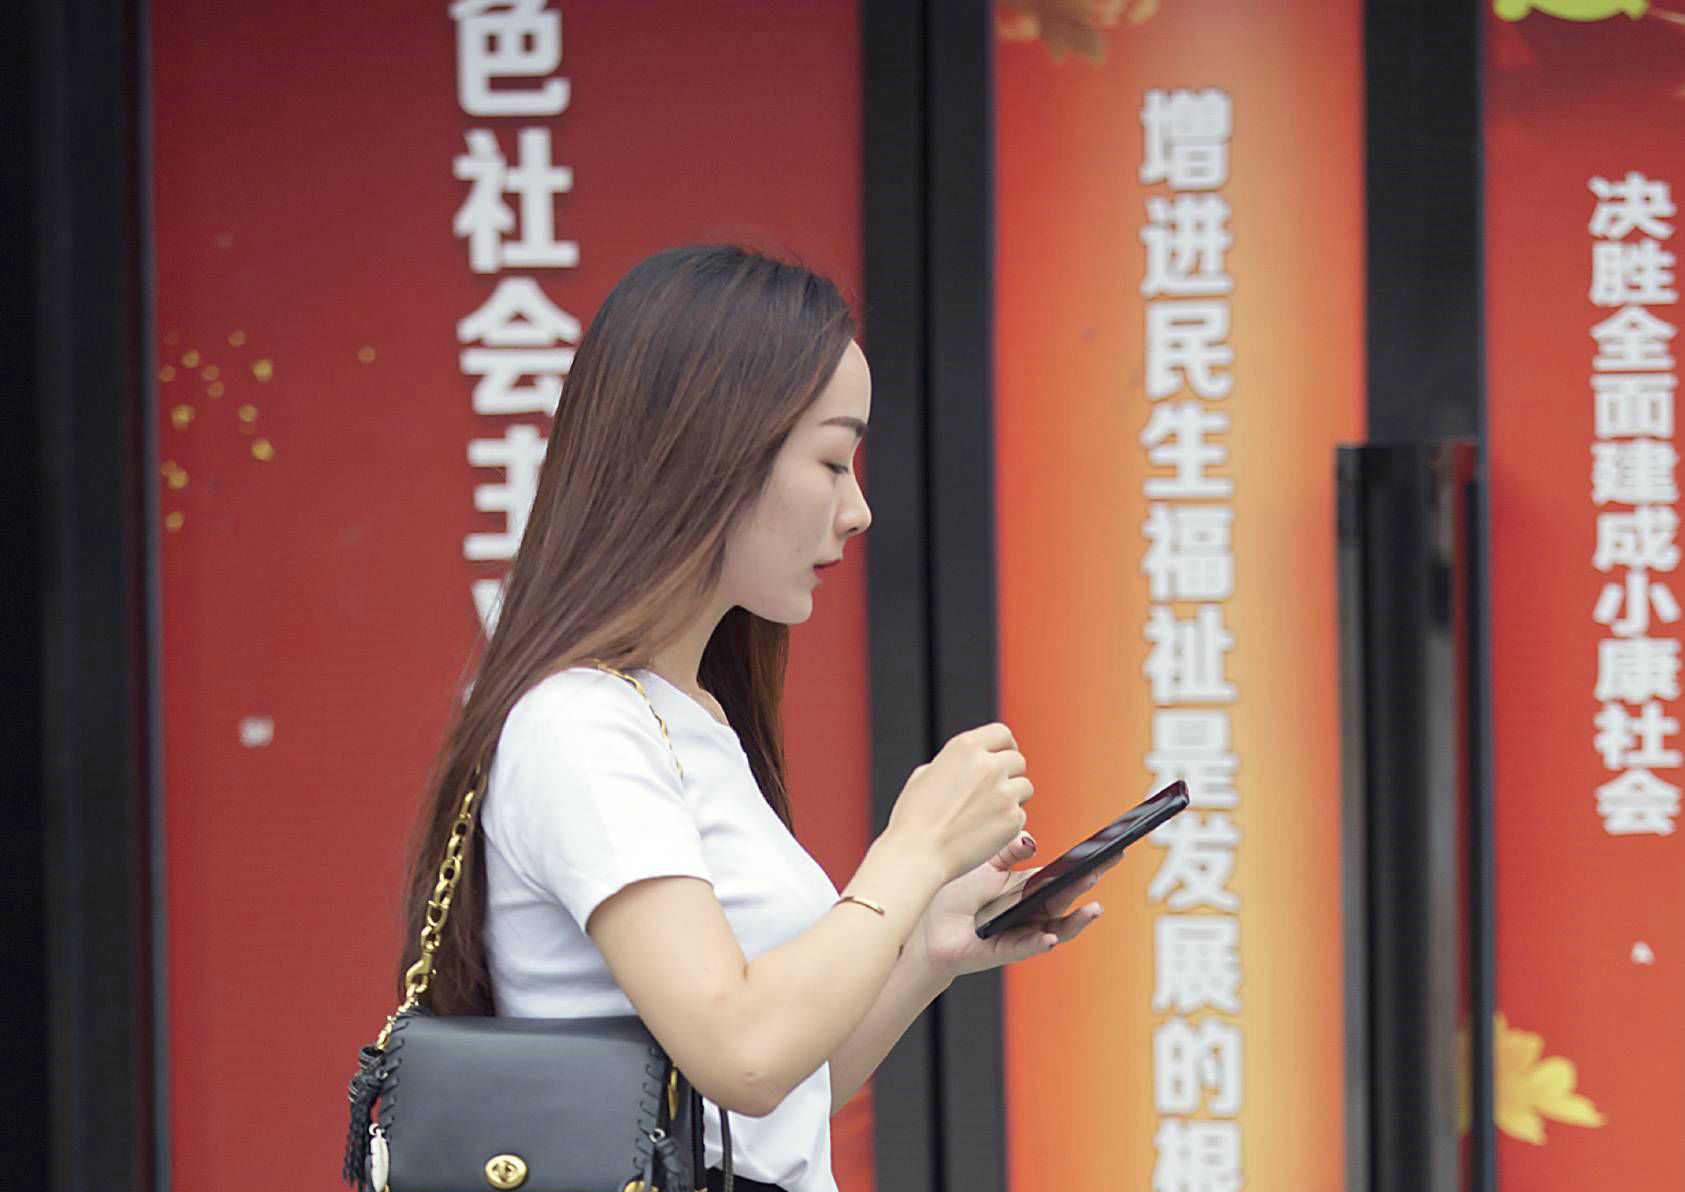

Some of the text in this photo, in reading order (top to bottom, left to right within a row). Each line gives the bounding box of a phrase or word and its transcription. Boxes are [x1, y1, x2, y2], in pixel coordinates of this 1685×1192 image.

[449, 0, 581, 638] 色社会主
[1588, 172, 1682, 836] 决胜全面建成小康社会
